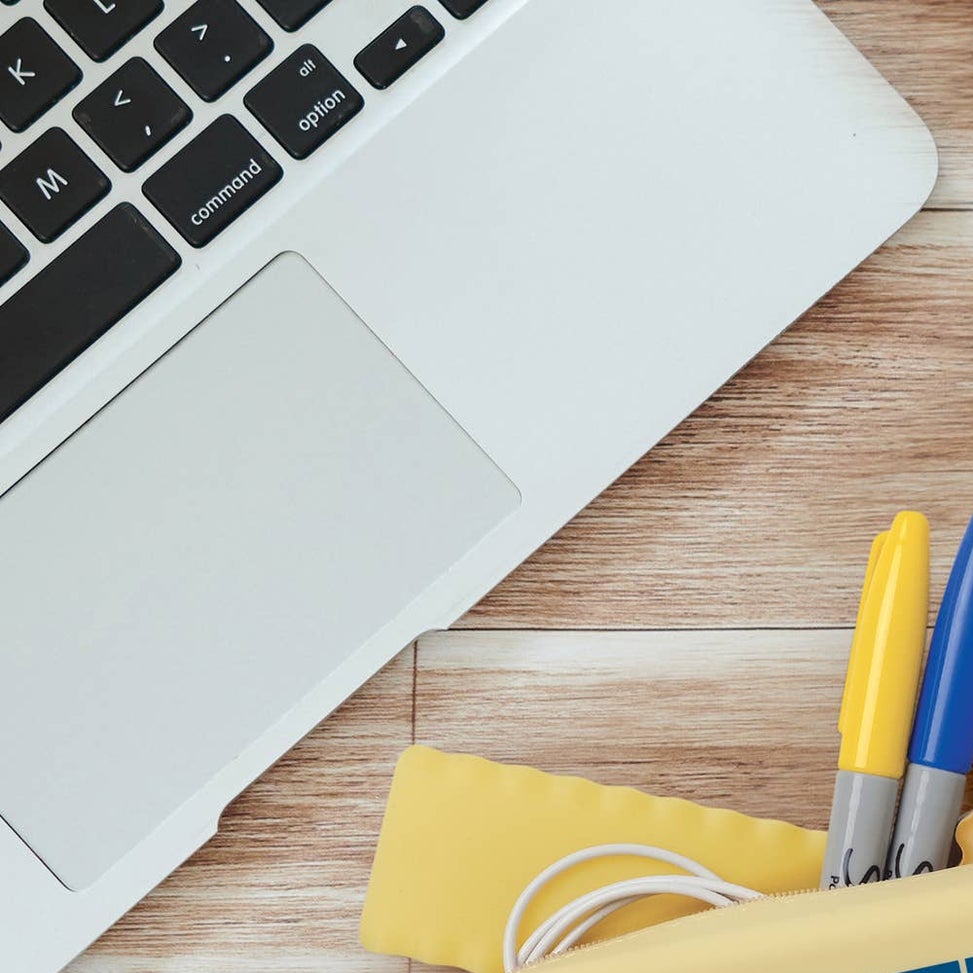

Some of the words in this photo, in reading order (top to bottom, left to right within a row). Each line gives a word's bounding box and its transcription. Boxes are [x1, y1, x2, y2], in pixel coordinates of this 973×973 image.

[191, 24, 208, 41] >
[7, 58, 36, 86] K
[299, 58, 317, 78] alt
[113, 89, 132, 107] <
[298, 87, 347, 132] option
[35, 168, 69, 200] M
[190, 157, 263, 227] command
